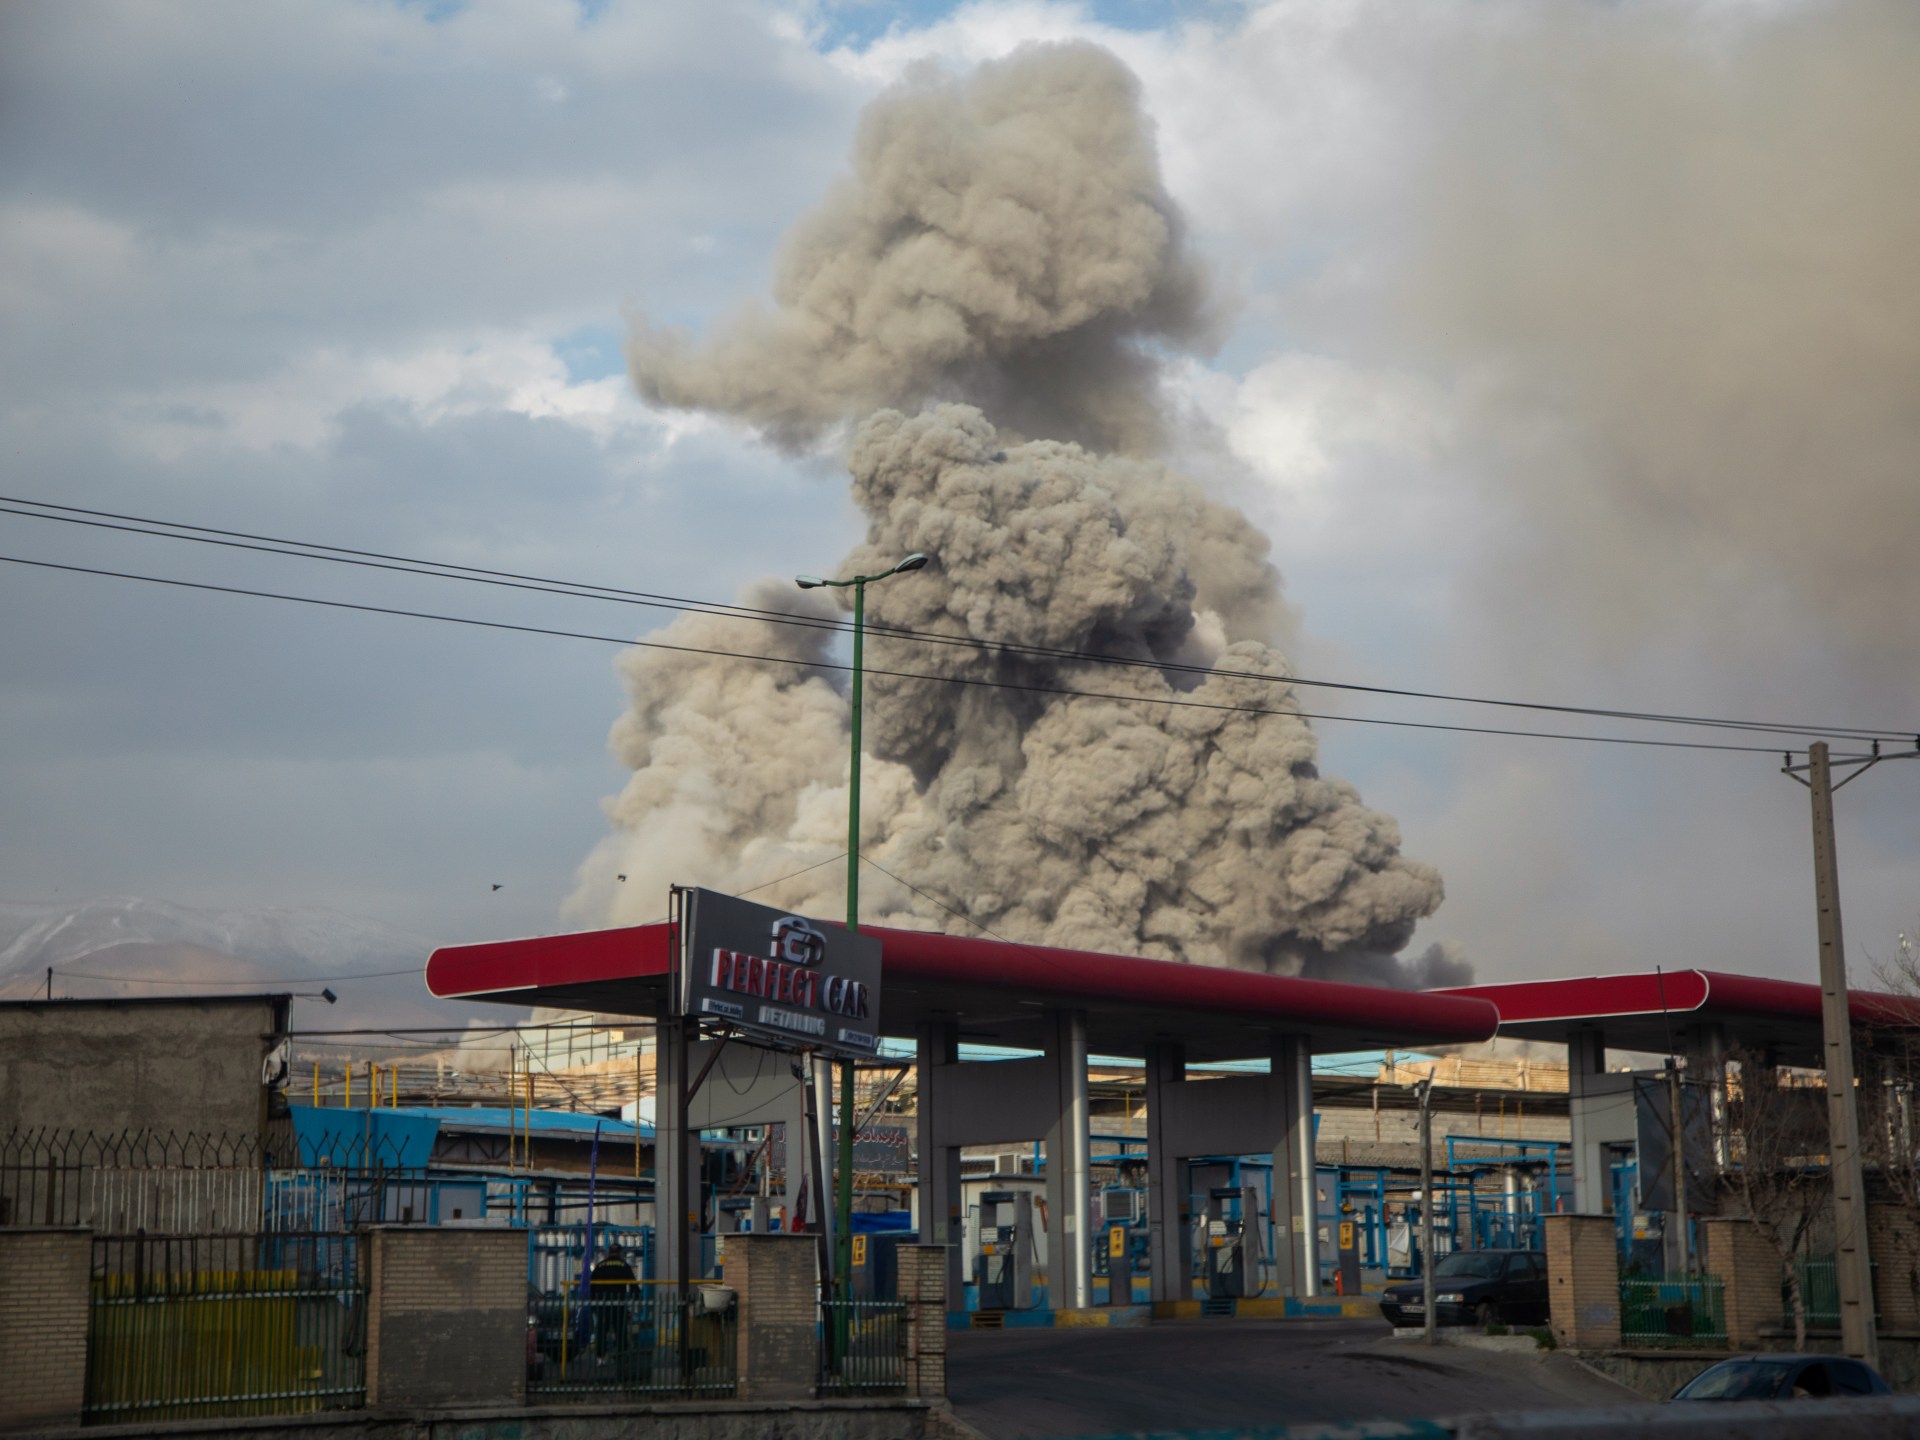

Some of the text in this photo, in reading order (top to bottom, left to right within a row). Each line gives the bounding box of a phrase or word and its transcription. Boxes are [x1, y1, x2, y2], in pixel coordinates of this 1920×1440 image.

[711, 948, 870, 1019] PERFECT CAR
[758, 1005, 825, 1037] DETAILING
